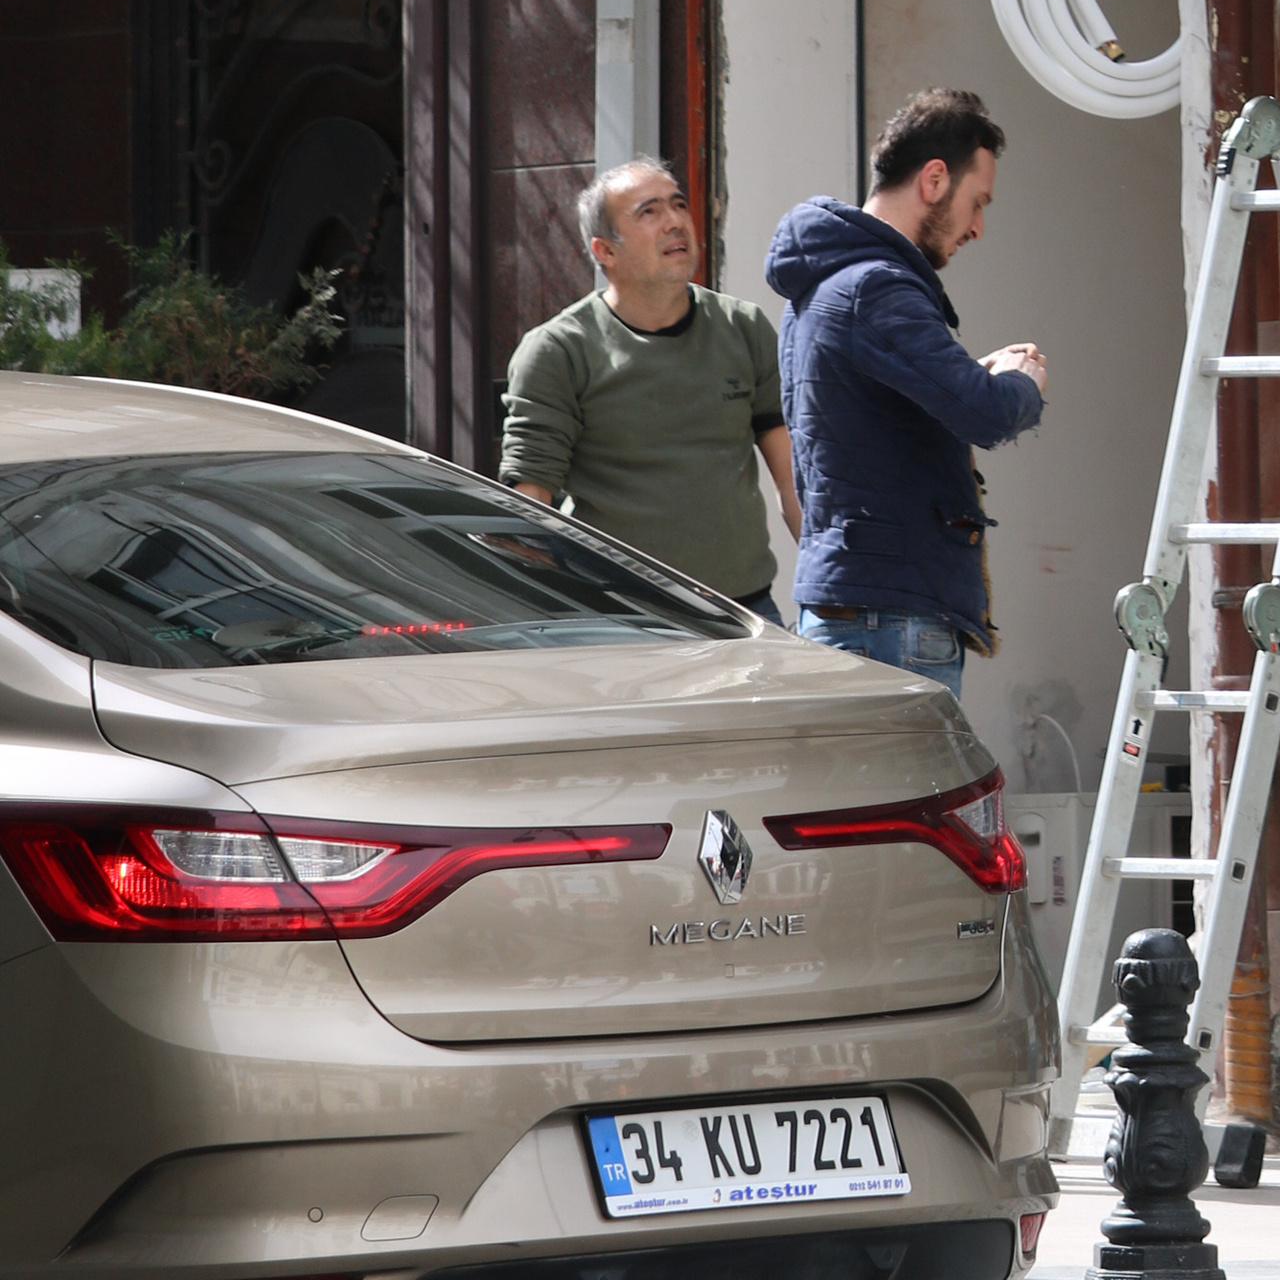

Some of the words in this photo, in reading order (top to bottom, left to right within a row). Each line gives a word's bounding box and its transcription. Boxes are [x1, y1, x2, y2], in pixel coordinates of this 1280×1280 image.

[650, 913, 806, 946] MEGANE
[622, 1119, 683, 1185] 34
[700, 1112, 762, 1178] KU
[776, 1106, 886, 1172] 7221
[603, 1163, 627, 1182] TR
[729, 1182, 818, 1202] ateştur
[849, 1181, 866, 1192] 0212
[867, 1180, 882, 1191] 541
